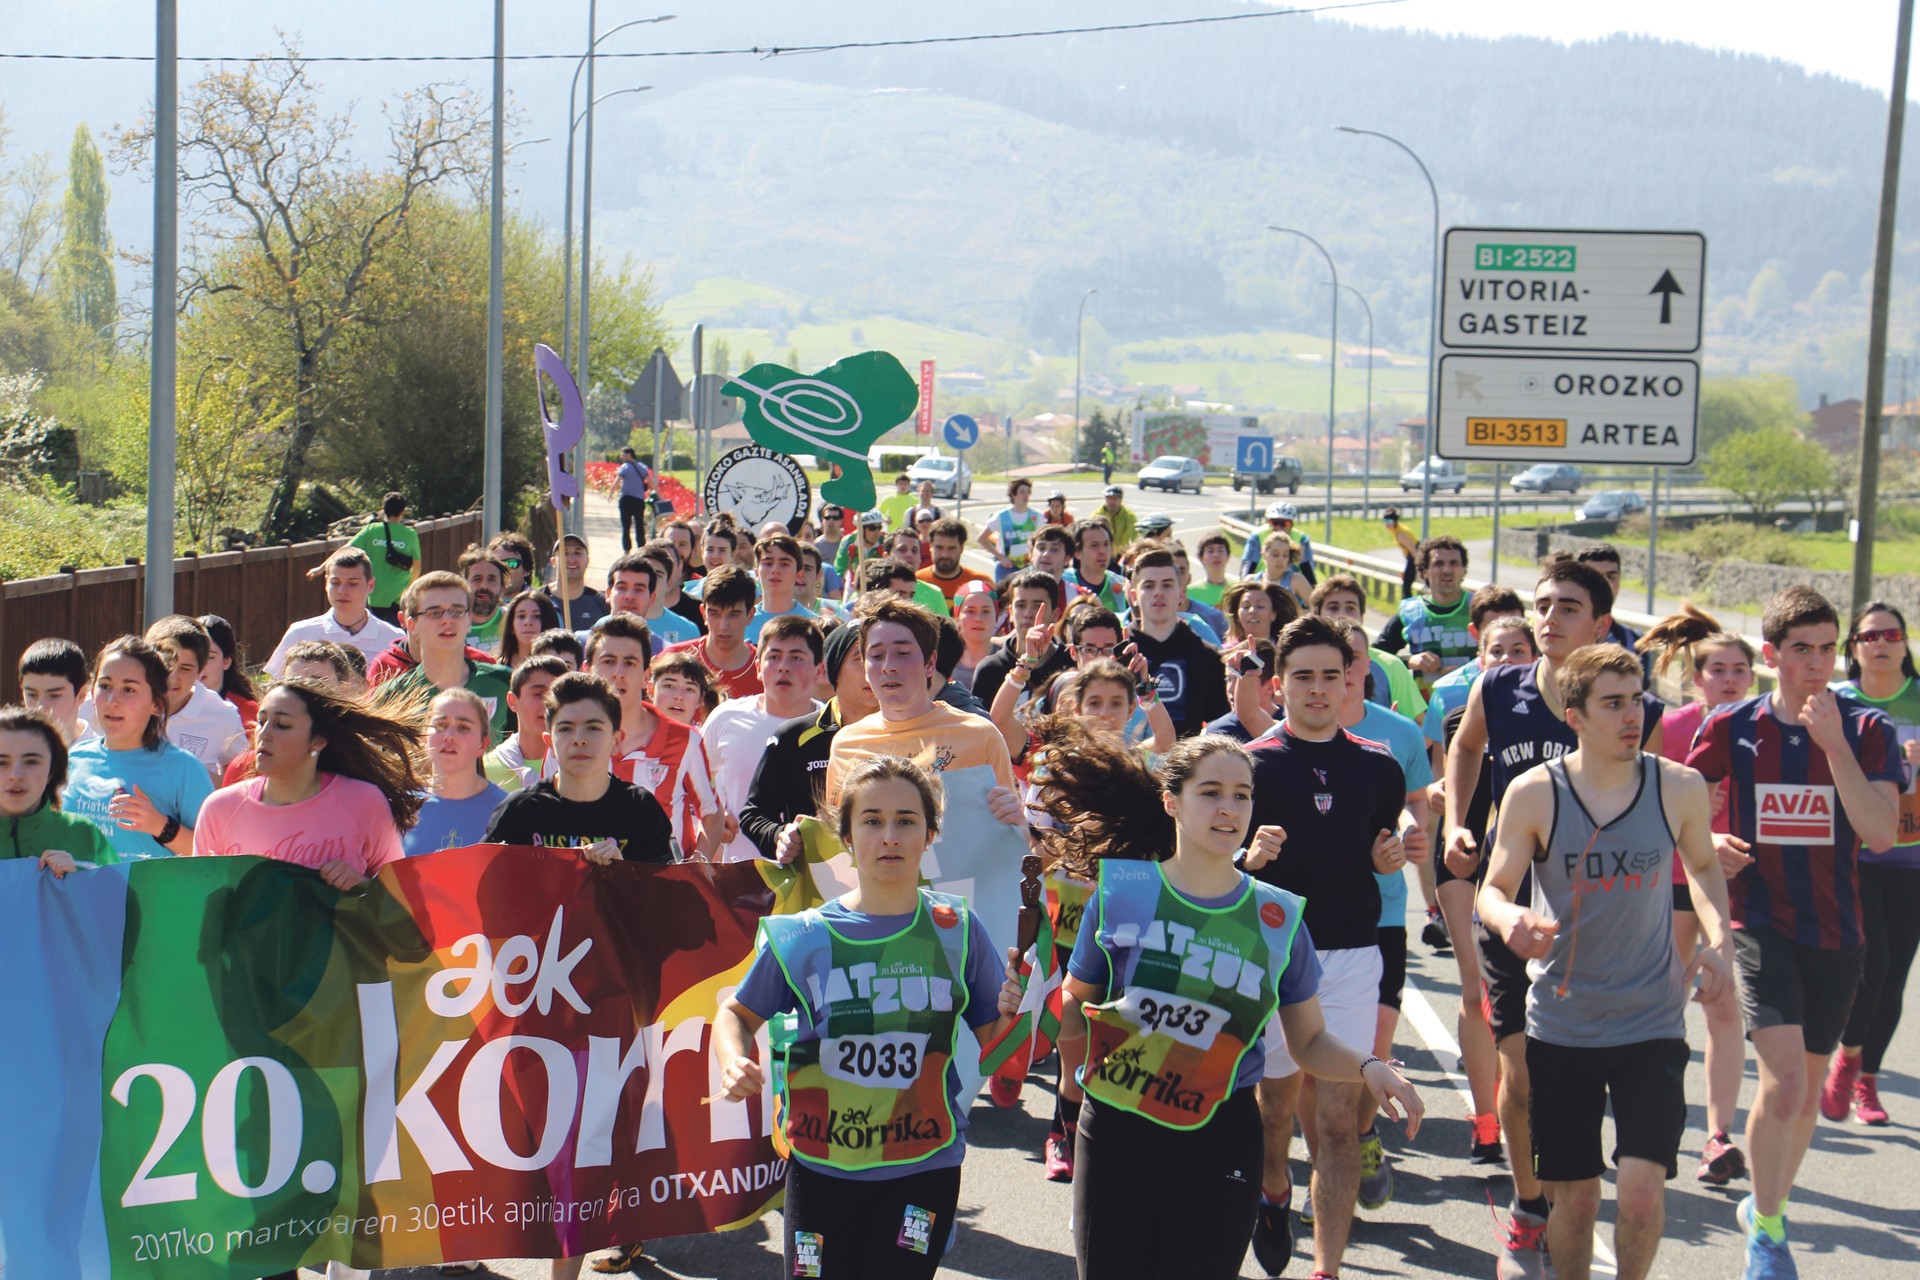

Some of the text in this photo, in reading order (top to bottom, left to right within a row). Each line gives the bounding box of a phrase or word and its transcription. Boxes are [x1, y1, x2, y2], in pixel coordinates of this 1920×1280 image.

[1479, 247, 1572, 268] BI-2522
[1460, 279, 1590, 301] VITORIA-
[1459, 313, 1588, 336] GASTEIZ
[1554, 374, 1683, 397] OROZKO
[1473, 422, 1680, 446] BI-3513 ARTEA
[706, 446, 809, 518] ROZKOKO GAZTE ASANBLADA
[1502, 741, 1534, 767] NEW
[1565, 850, 1630, 879] FOX
[425, 904, 593, 1018] aek
[1181, 942, 1266, 1001] ZUK
[838, 1040, 918, 1080] 2033
[130, 1228, 214, 1261] 2017ko
[226, 1214, 398, 1250] martxoaren
[406, 1197, 494, 1232] 30etik
[504, 1190, 605, 1230] apirilaren
[904, 1216, 928, 1231] BAT
[904, 1227, 929, 1243] ZUK
[798, 1254, 819, 1265] ZUK
